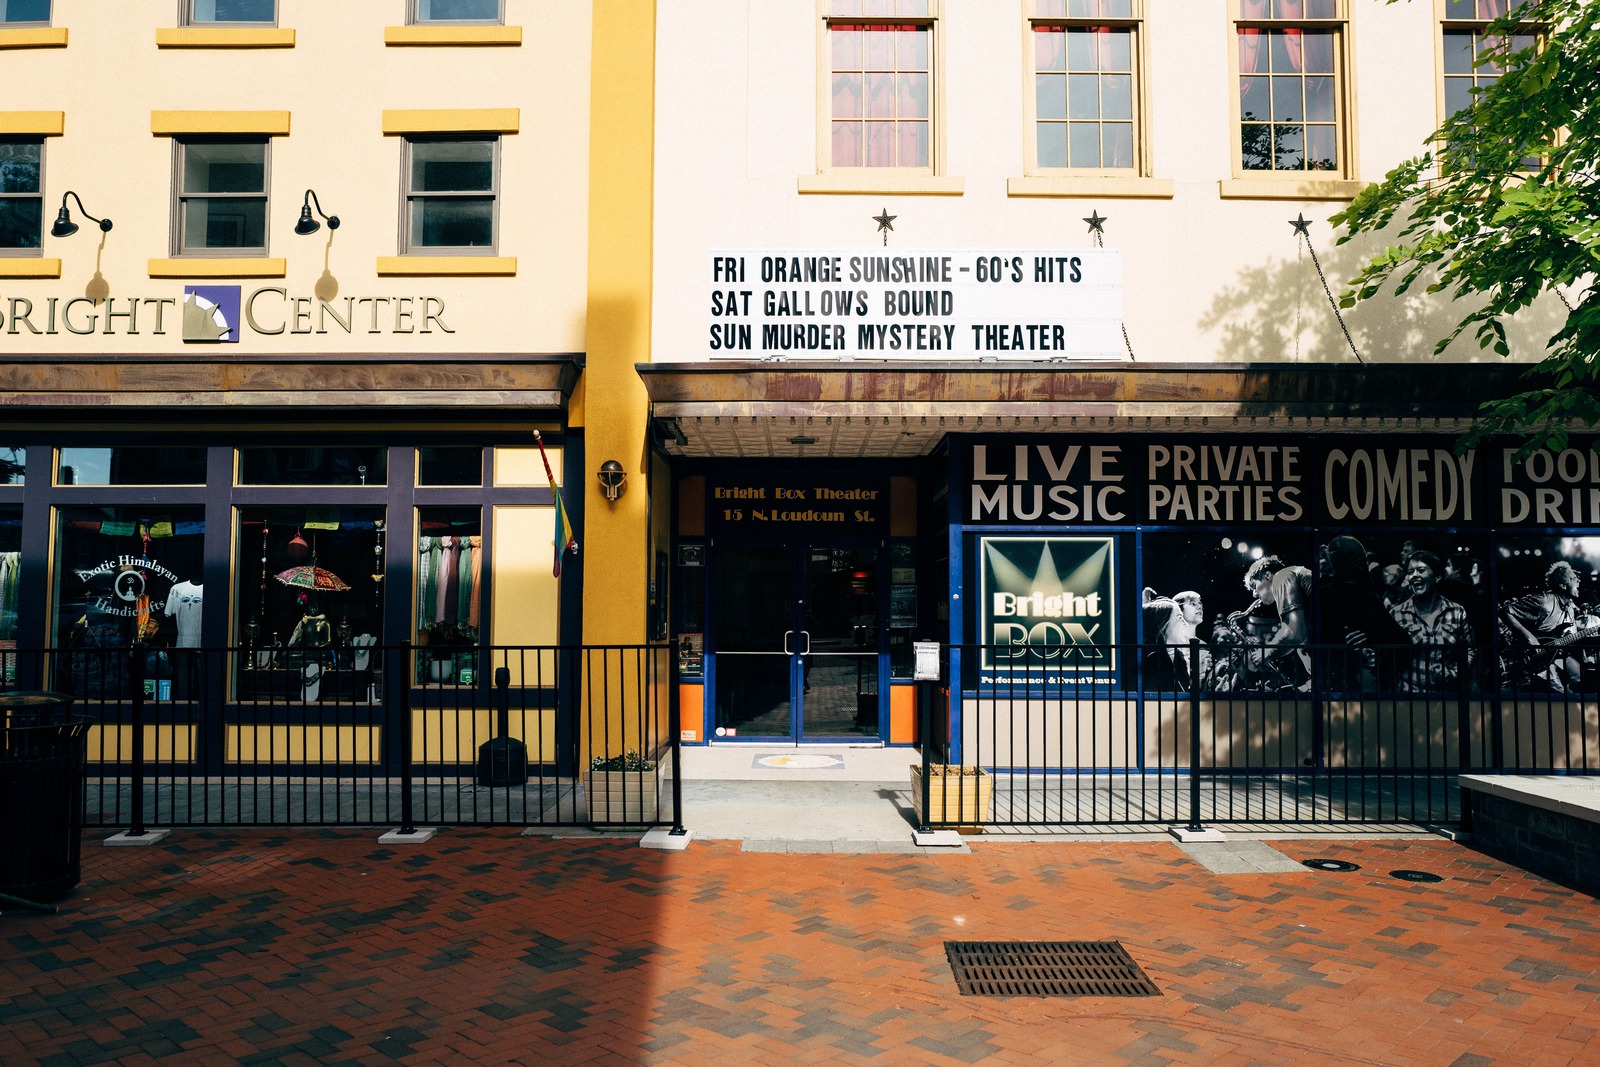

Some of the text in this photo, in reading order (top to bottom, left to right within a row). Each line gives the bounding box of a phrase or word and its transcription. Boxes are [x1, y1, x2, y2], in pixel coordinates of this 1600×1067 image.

[713, 257, 745, 283] FRI
[761, 256, 842, 283] ORANGE
[850, 256, 952, 283] SUNSHINE
[1034, 256, 1082, 283] HITS
[0, 287, 455, 335] RIGHT CENTER
[711, 290, 953, 317] SAT GALLOWS BOUND
[709, 323, 1065, 350] SUN MURDER MYSTERY THEATER
[973, 445, 1125, 482] LIVE
[1148, 445, 1302, 482] PRIVATE
[714, 487, 879, 500] Bright Box Theater
[1324, 448, 1476, 521] COMEDY
[723, 508, 875, 523] 15 N. Loudoun St.
[971, 484, 1126, 521] MUSIC
[1148, 484, 1303, 522] PARTIES
[79, 554, 179, 583] Exotic Himalayan
[95, 597, 165, 617] Handicrafts
[993, 591, 1102, 618] Bright
[993, 621, 1103, 659] BOX
[1048, 676, 1056, 684] &
